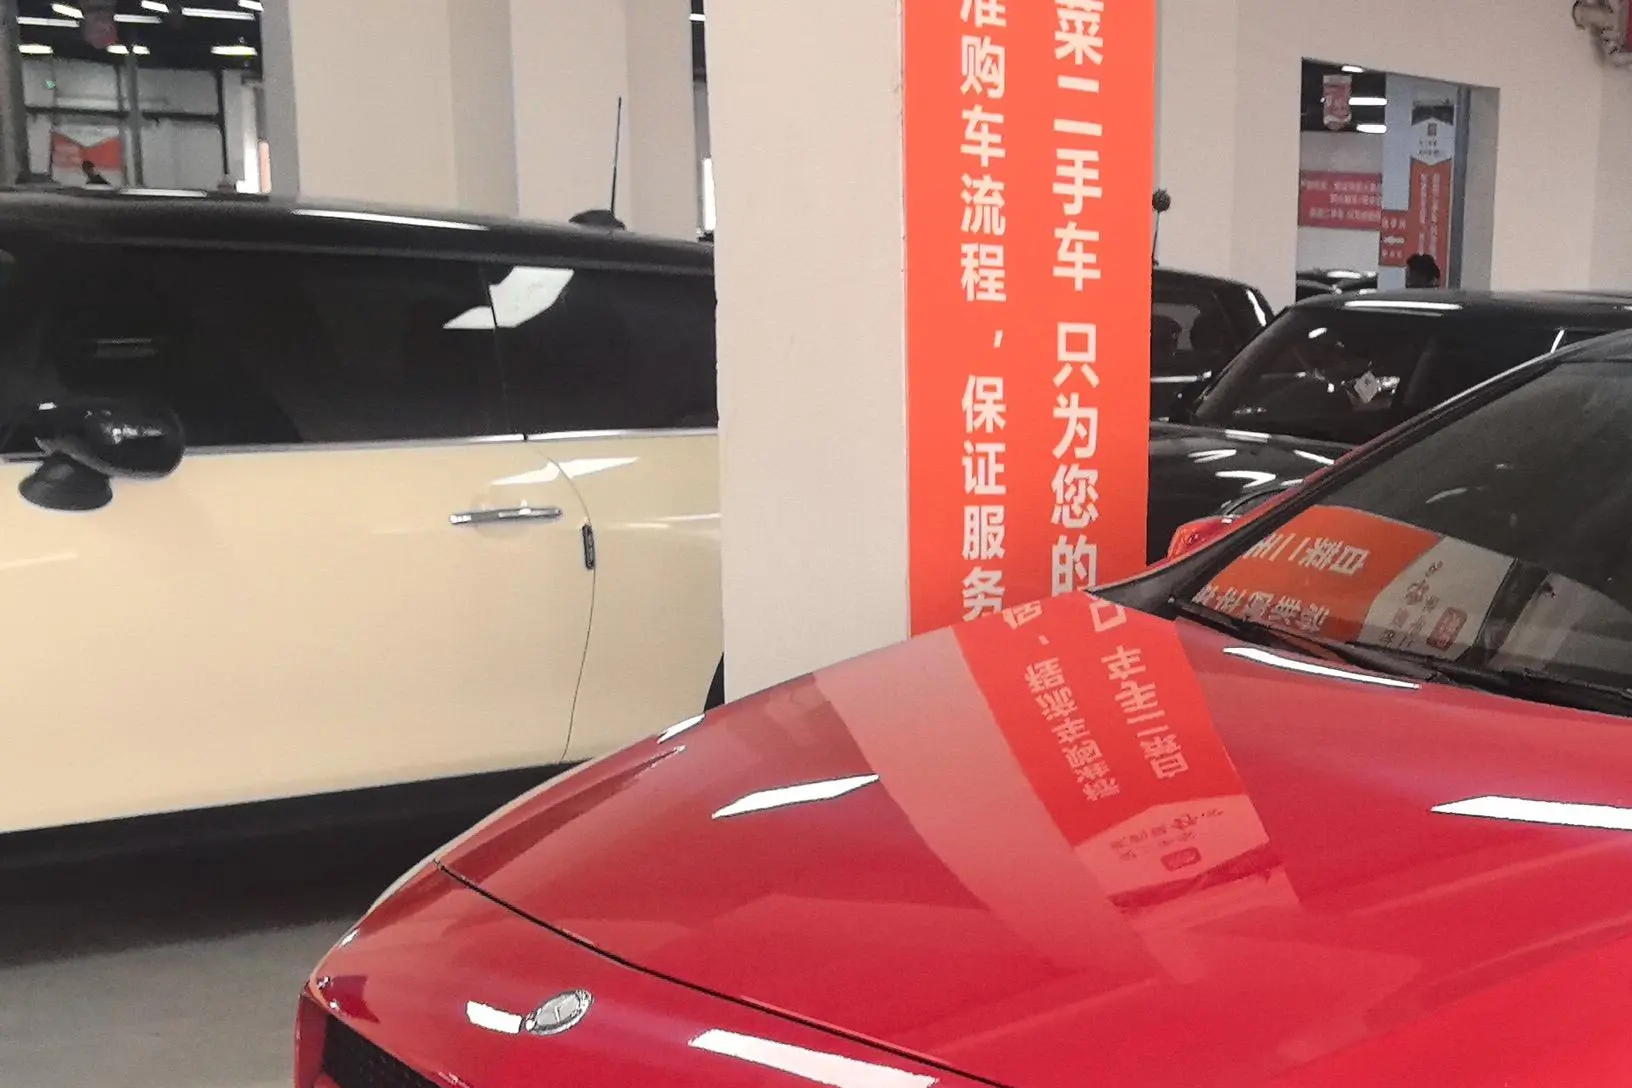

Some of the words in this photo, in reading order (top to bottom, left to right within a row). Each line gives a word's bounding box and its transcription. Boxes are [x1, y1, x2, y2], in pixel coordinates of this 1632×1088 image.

[1051, 0, 1104, 292] 菜二手车
[1050, 321, 1100, 598] 只为您的
